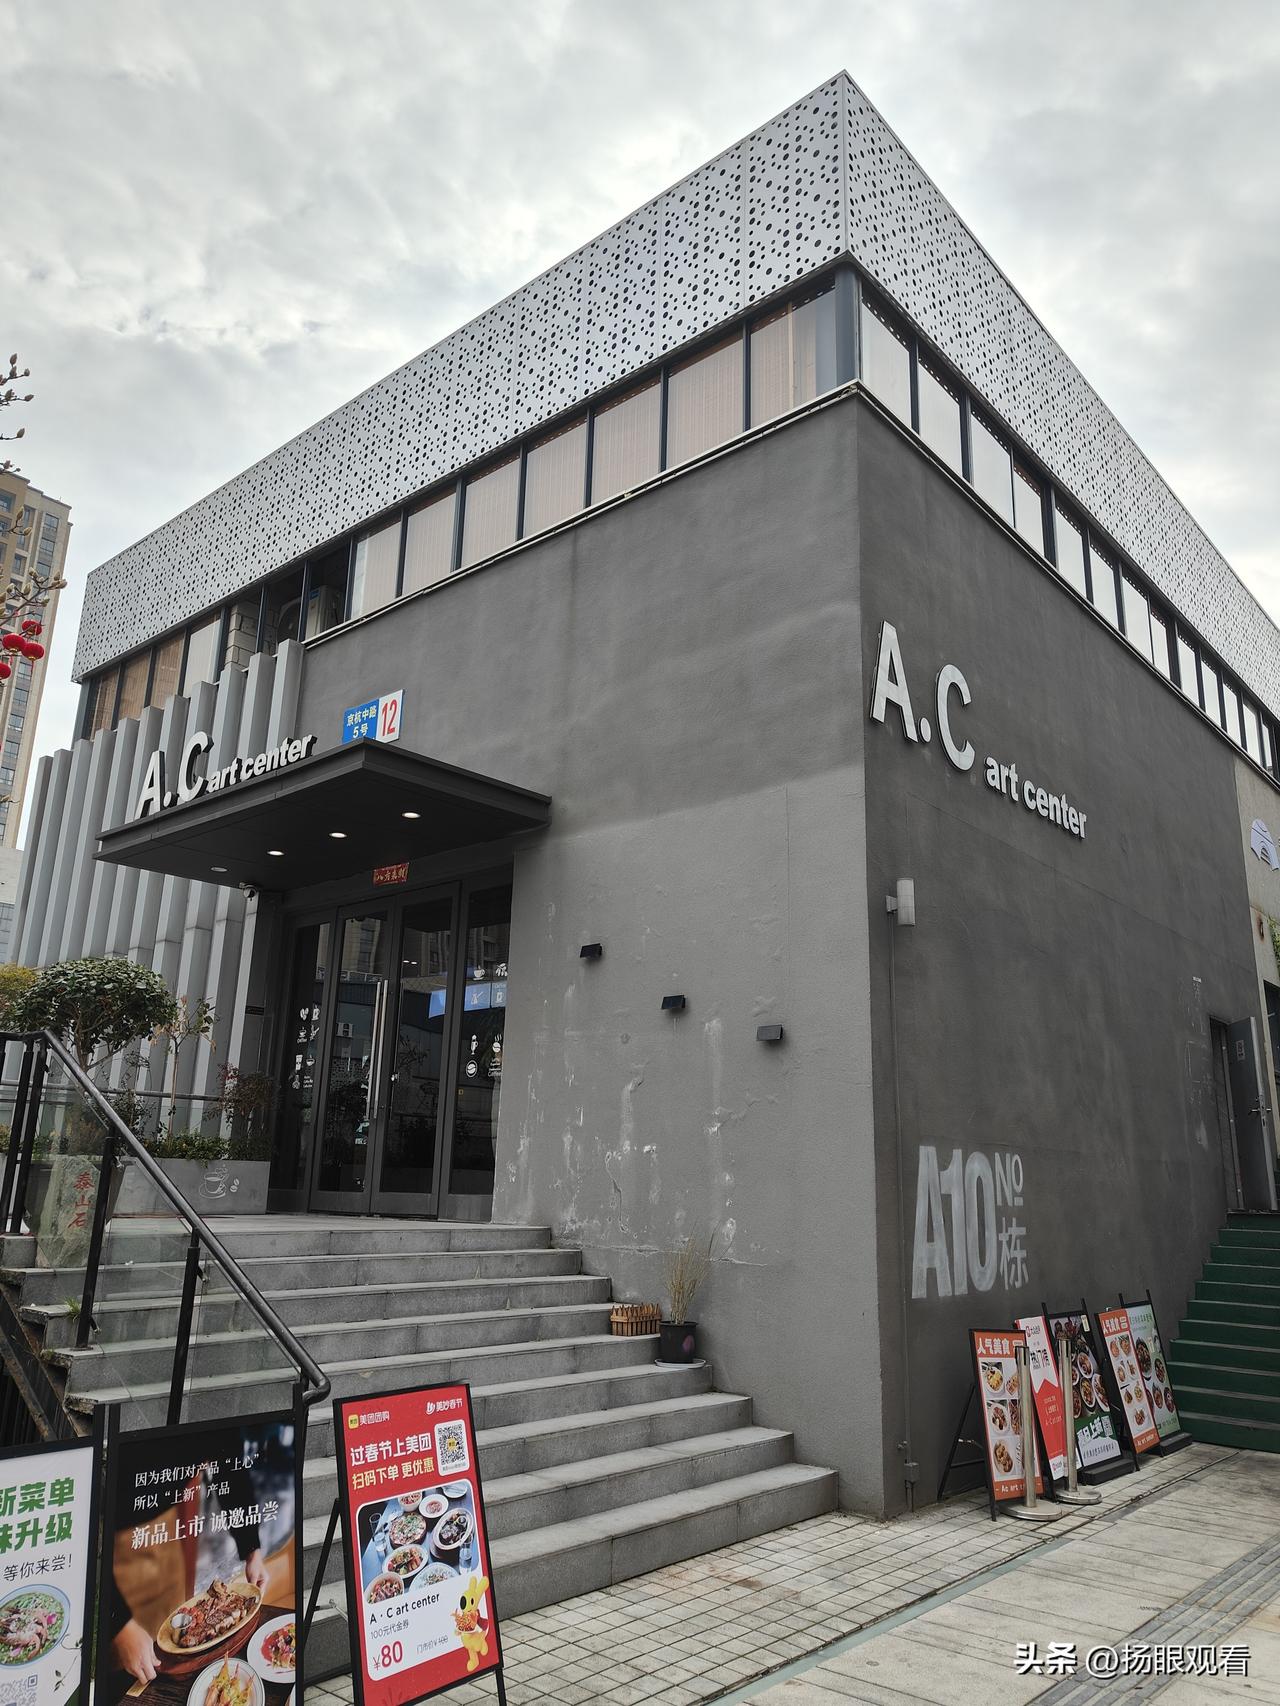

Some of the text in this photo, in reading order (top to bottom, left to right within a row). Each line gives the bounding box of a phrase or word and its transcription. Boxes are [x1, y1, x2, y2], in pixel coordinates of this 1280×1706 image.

[346, 705, 377, 728] 京杭中路
[352, 722, 369, 739] 5号
[382, 698, 398, 737] 12
[869, 620, 1087, 839] A.C art center
[134, 731, 317, 820] A.C art center
[911, 1145, 997, 1298] A10
[999, 1217, 1029, 1290] 栋
[350, 1432, 433, 1467] 过春节上美团
[352, 1464, 400, 1491] 扫码下单
[401, 1456, 435, 1479] 更优惠
[131, 1500, 279, 1551] 新品上市 诚邀品尝
[395, 1601, 409, 1616] art
[411, 1593, 440, 1611] center
[370, 1619, 409, 1640] 100元代金券
[372, 1640, 404, 1671] ¥80
